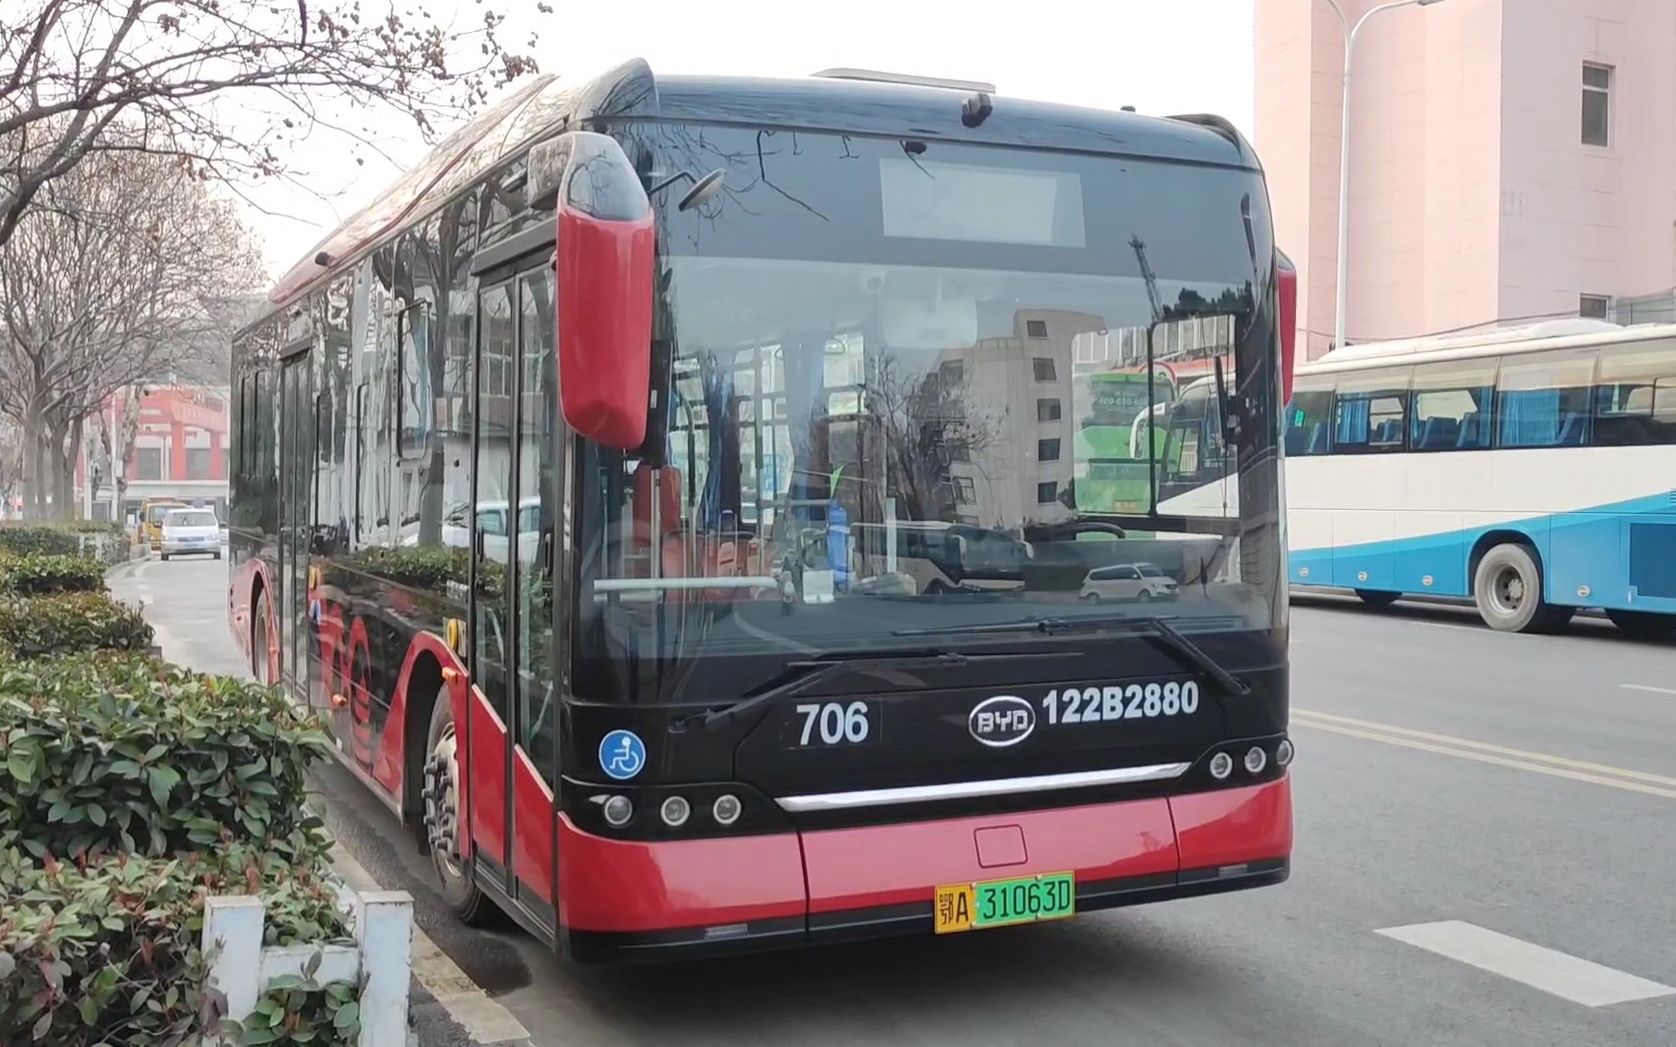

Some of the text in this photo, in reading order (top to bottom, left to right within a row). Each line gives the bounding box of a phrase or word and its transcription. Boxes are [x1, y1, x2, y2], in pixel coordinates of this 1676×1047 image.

[796, 701, 869, 746] 706
[977, 710, 1029, 733] BYD
[1043, 681, 1199, 724] 122B2880
[938, 879, 1071, 926] 鄂A 31063D
